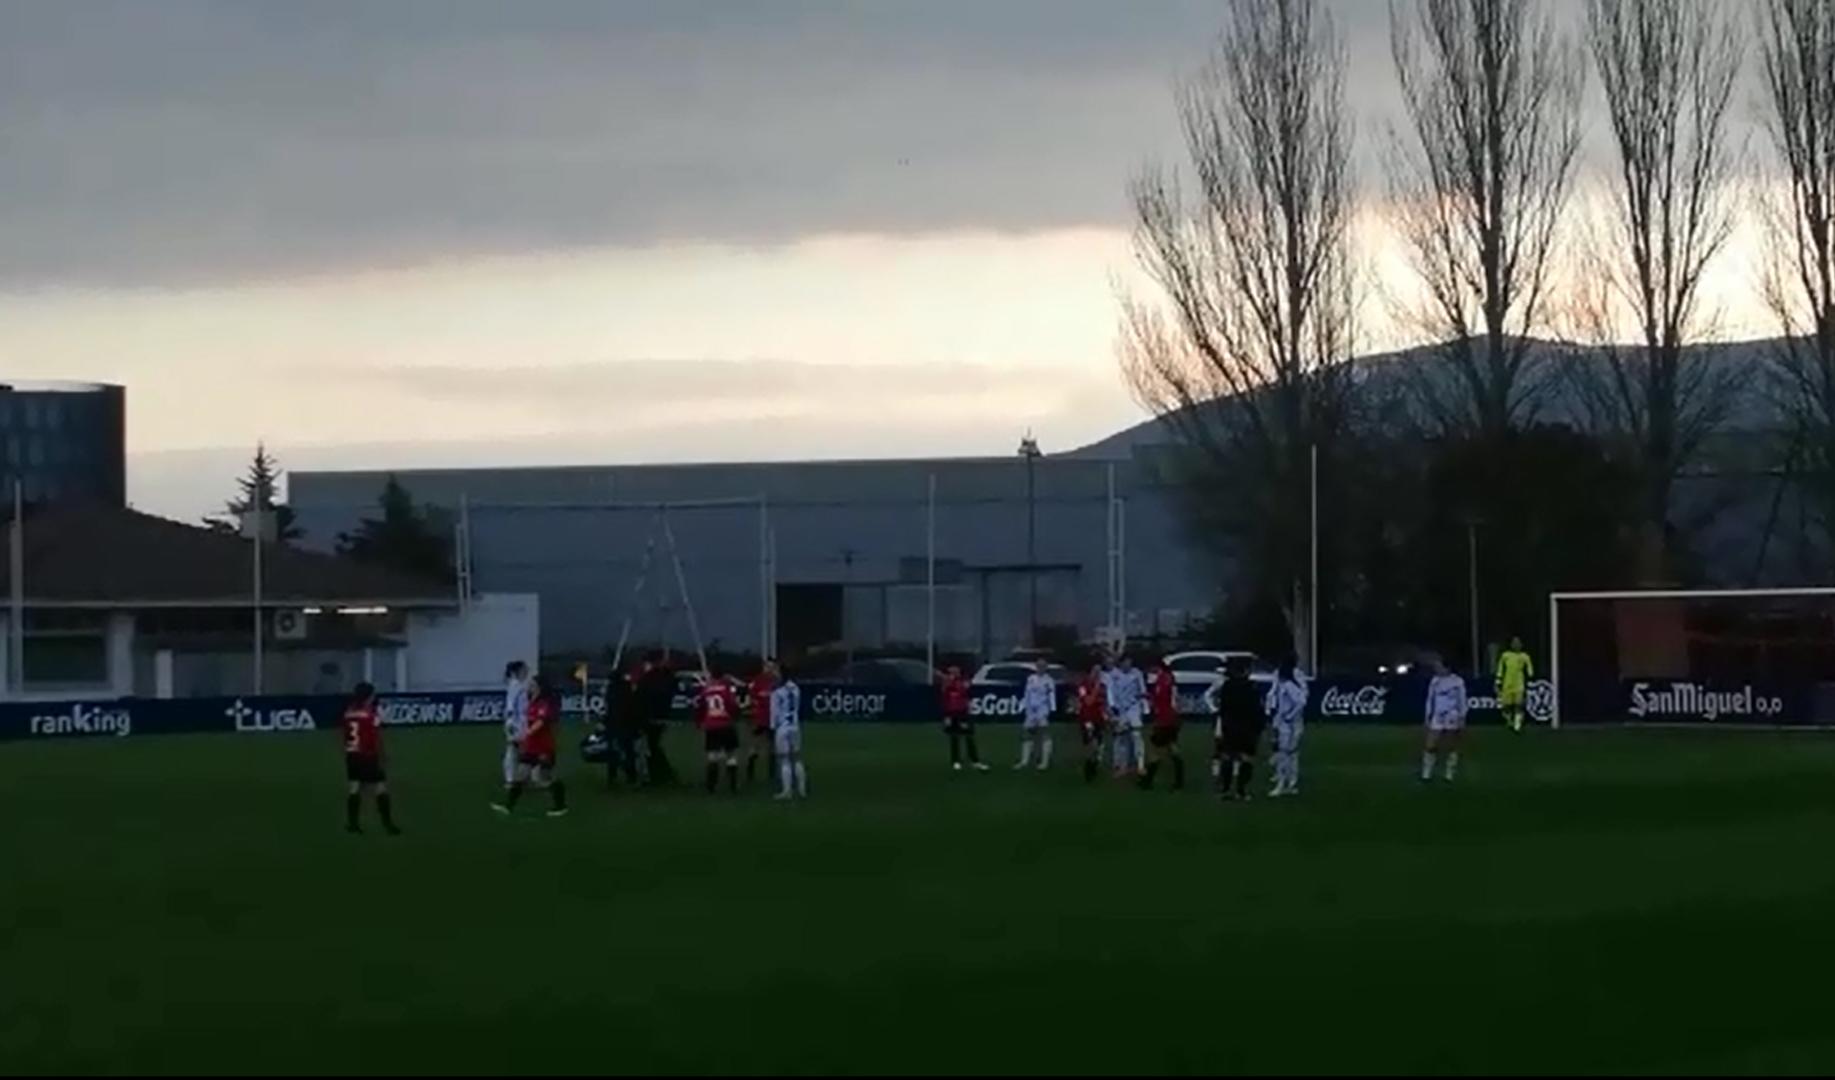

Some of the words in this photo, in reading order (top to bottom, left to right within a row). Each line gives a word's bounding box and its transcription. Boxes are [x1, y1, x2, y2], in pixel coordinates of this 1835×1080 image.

[811, 688, 887, 714] cidenar
[30, 703, 132, 736] ranking
[346, 720, 361, 746] 3
